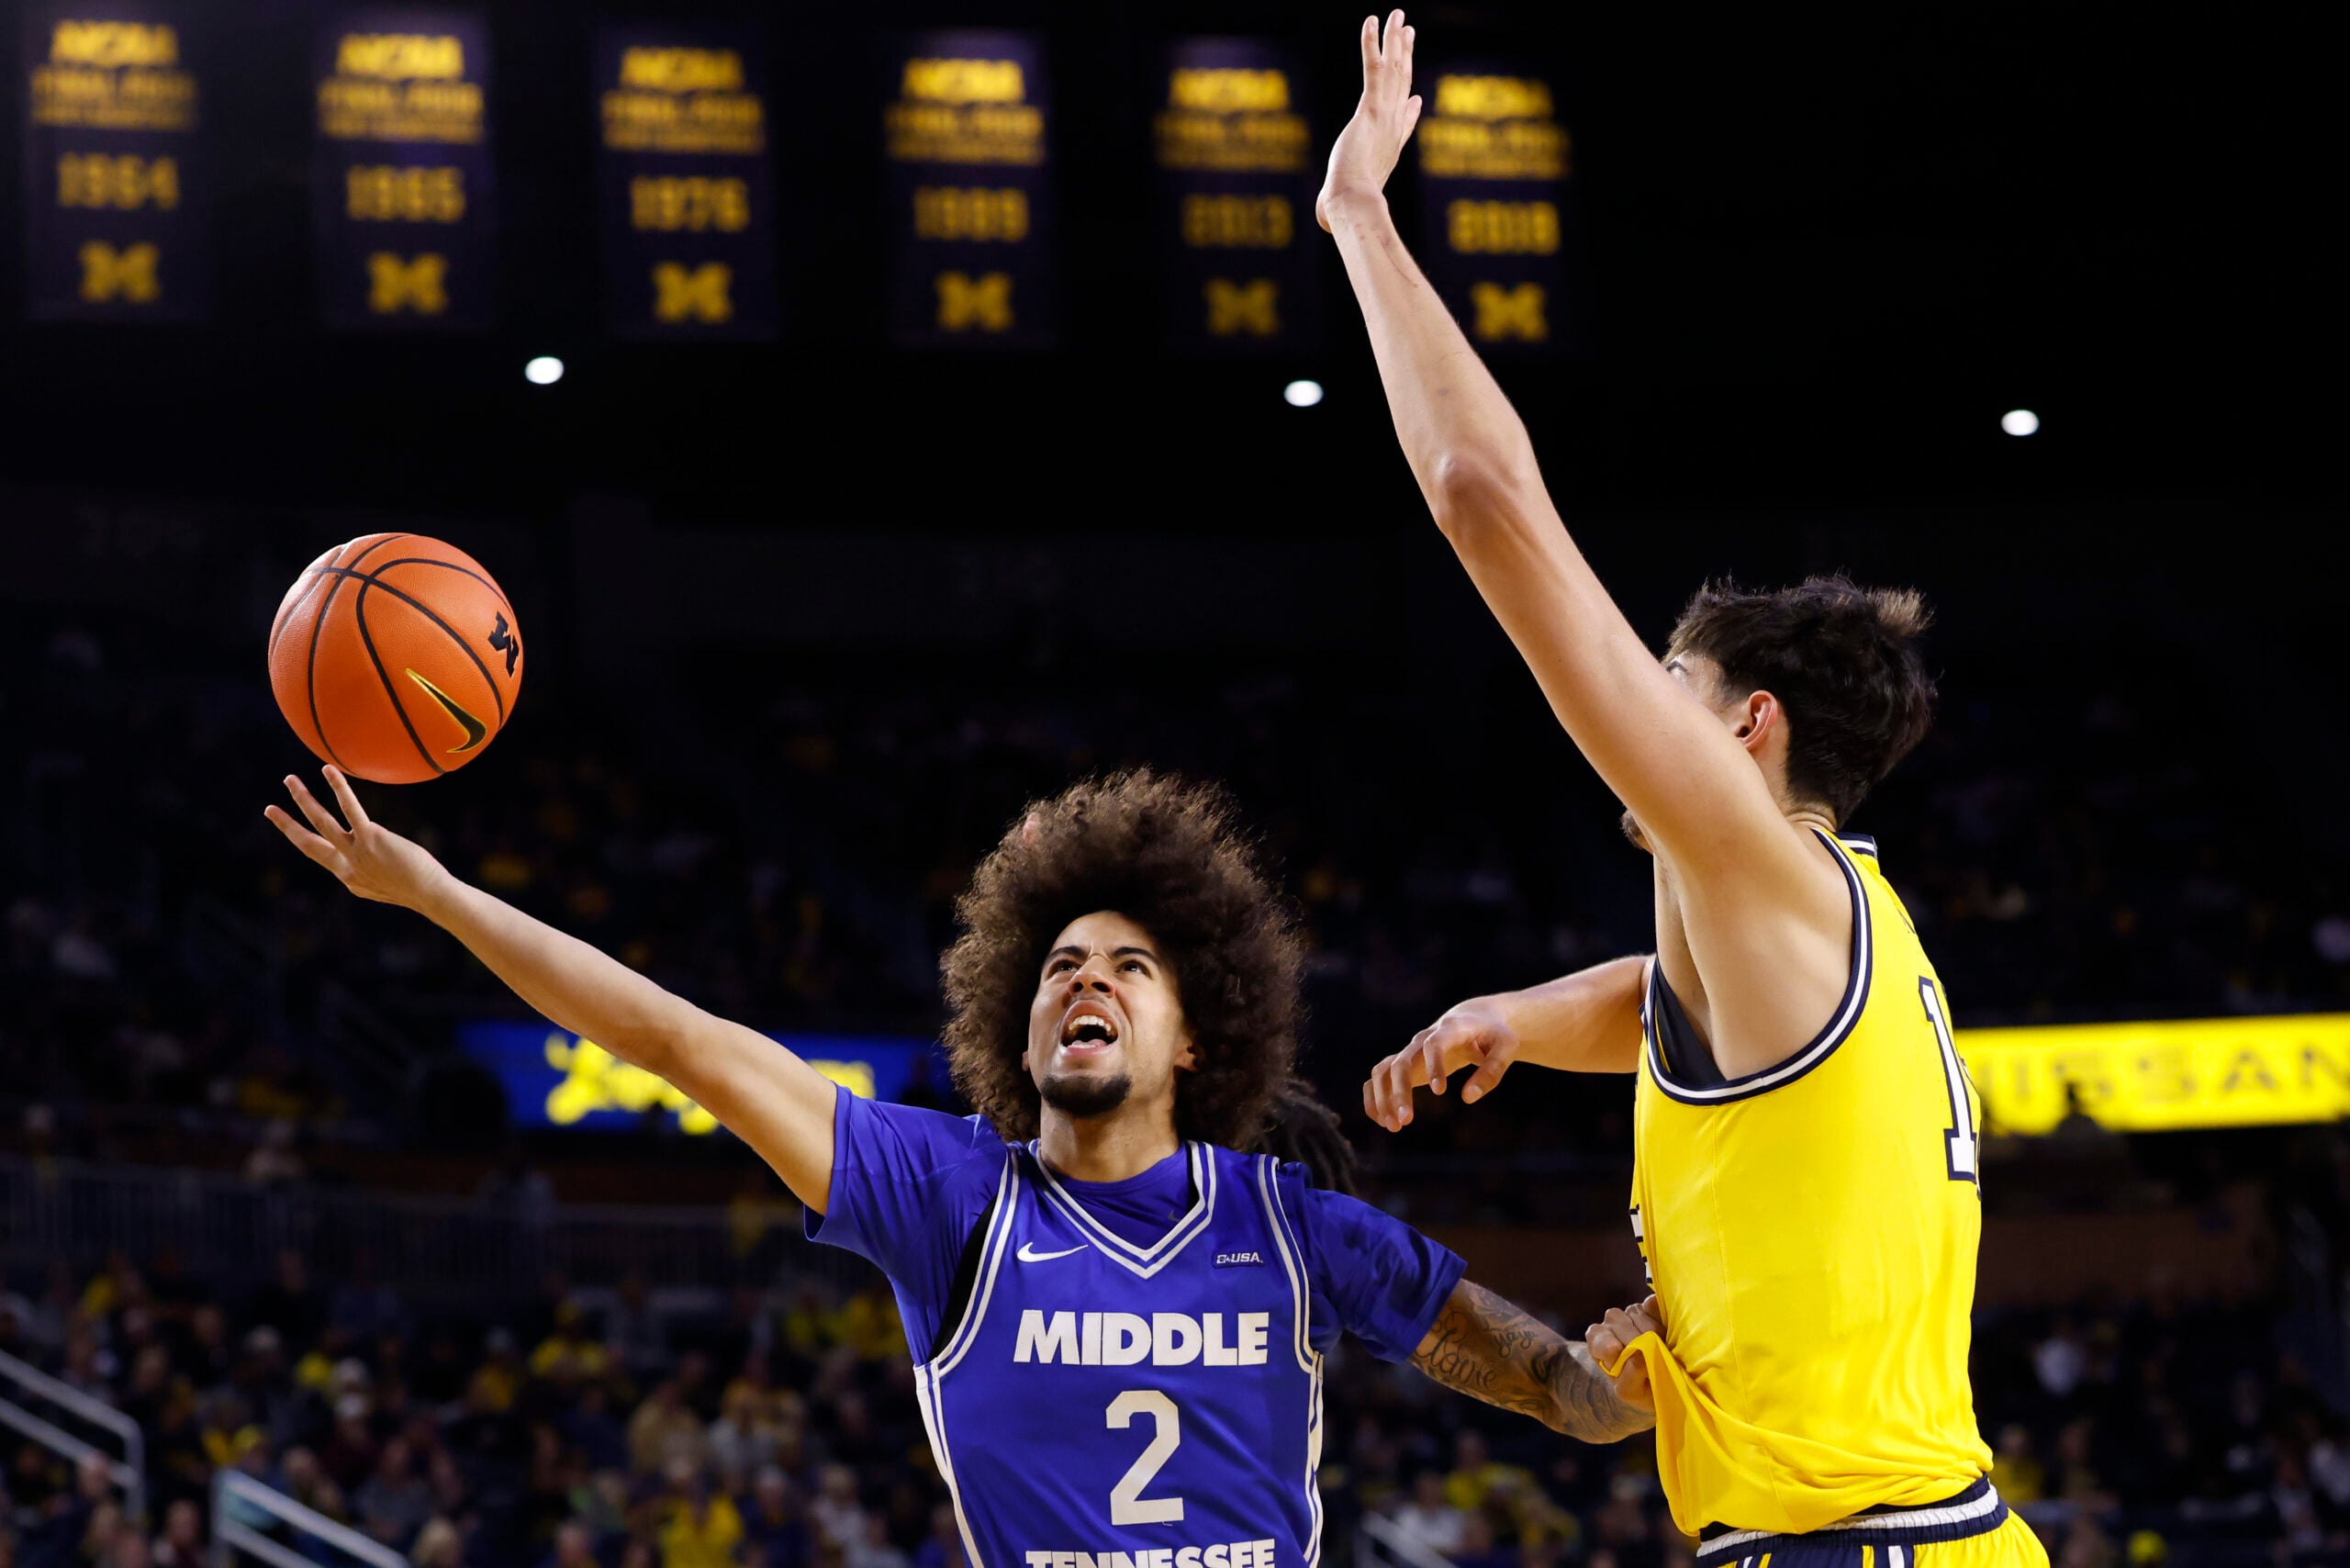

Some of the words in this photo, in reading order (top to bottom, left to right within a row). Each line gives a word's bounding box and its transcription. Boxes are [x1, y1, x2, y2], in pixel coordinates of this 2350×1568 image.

[1919, 975, 1982, 1200] 1
[1979, 1044, 2350, 1105] ISSAN
[1013, 1309, 1270, 1365] MIDDLE
[1105, 1390, 1184, 1526] 2
